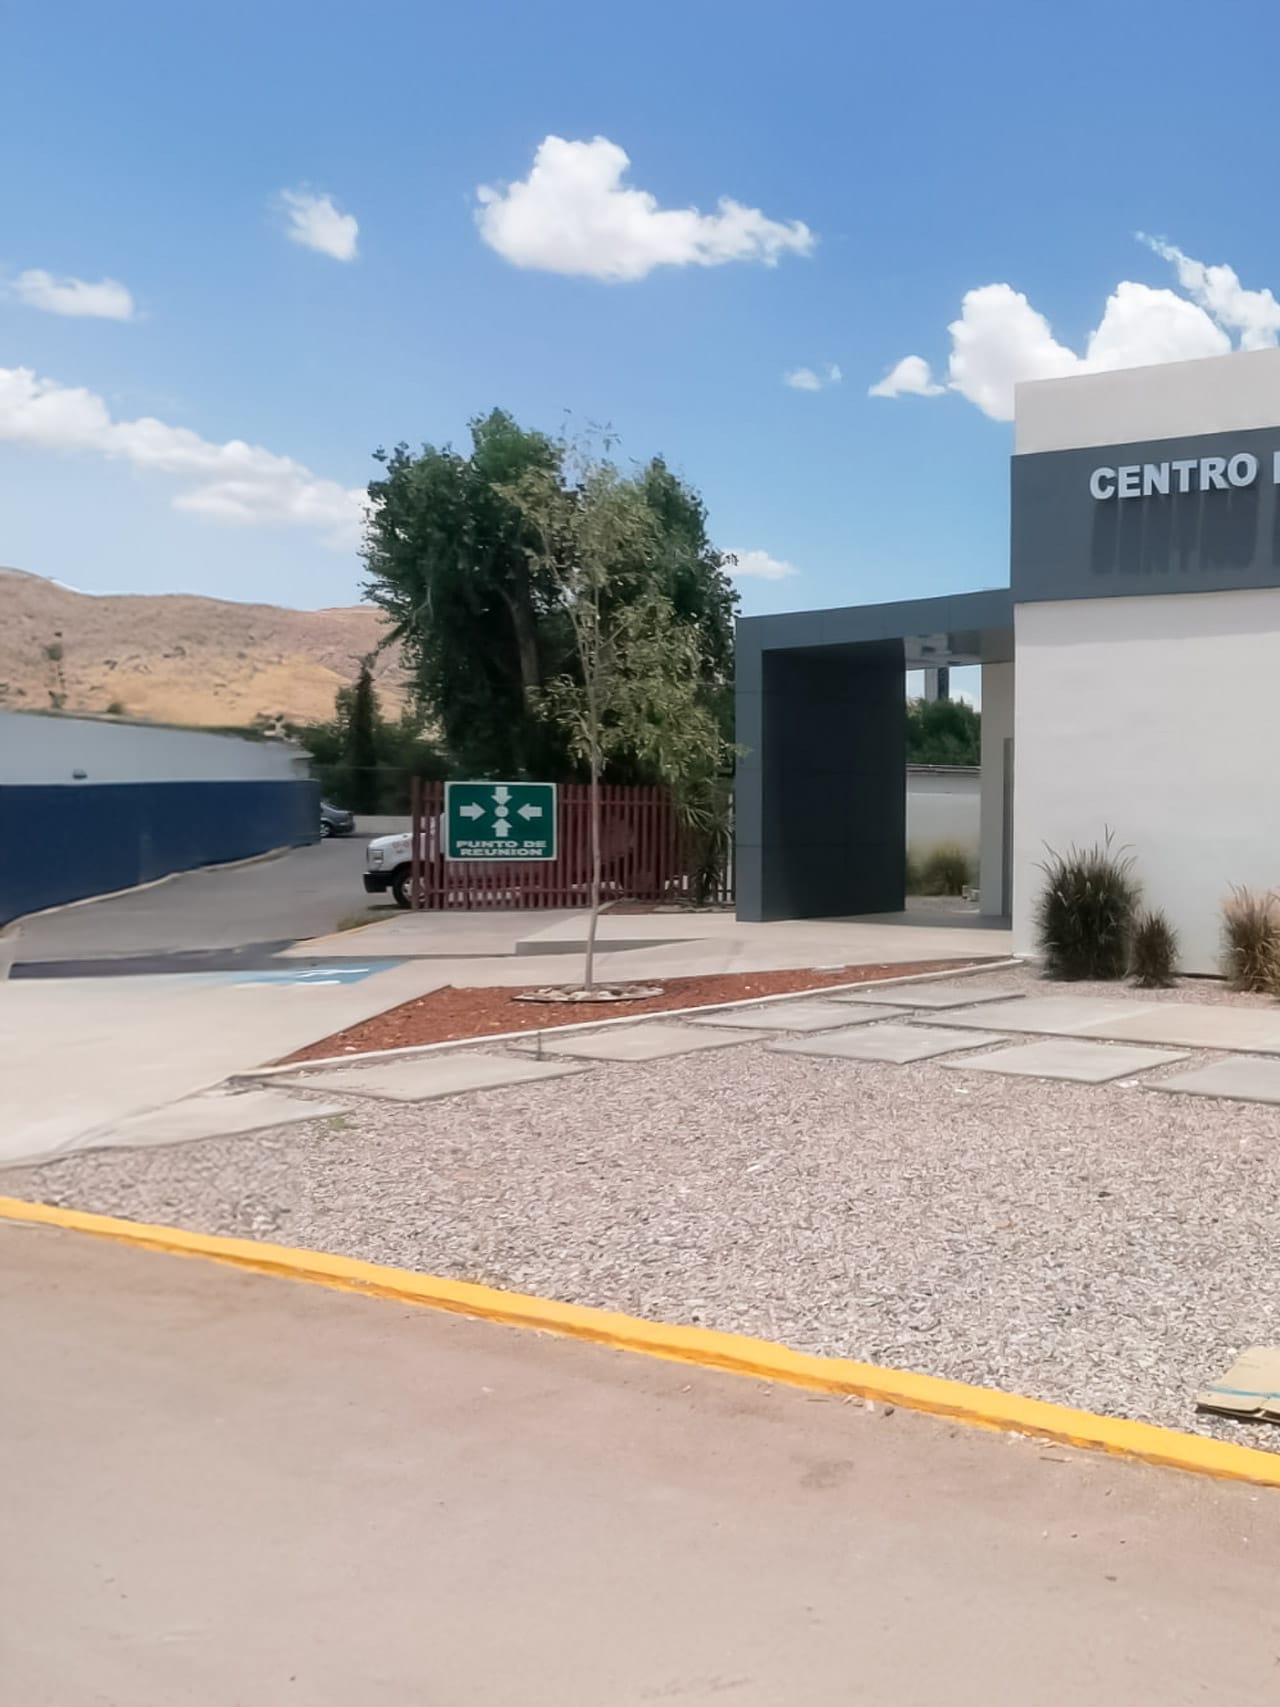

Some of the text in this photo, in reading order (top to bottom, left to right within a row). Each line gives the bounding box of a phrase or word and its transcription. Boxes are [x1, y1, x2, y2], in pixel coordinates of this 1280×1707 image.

[1090, 453, 1258, 500] CENTRO
[456, 840, 547, 848] PUNTO DE
[460, 848, 543, 856] REUNION
